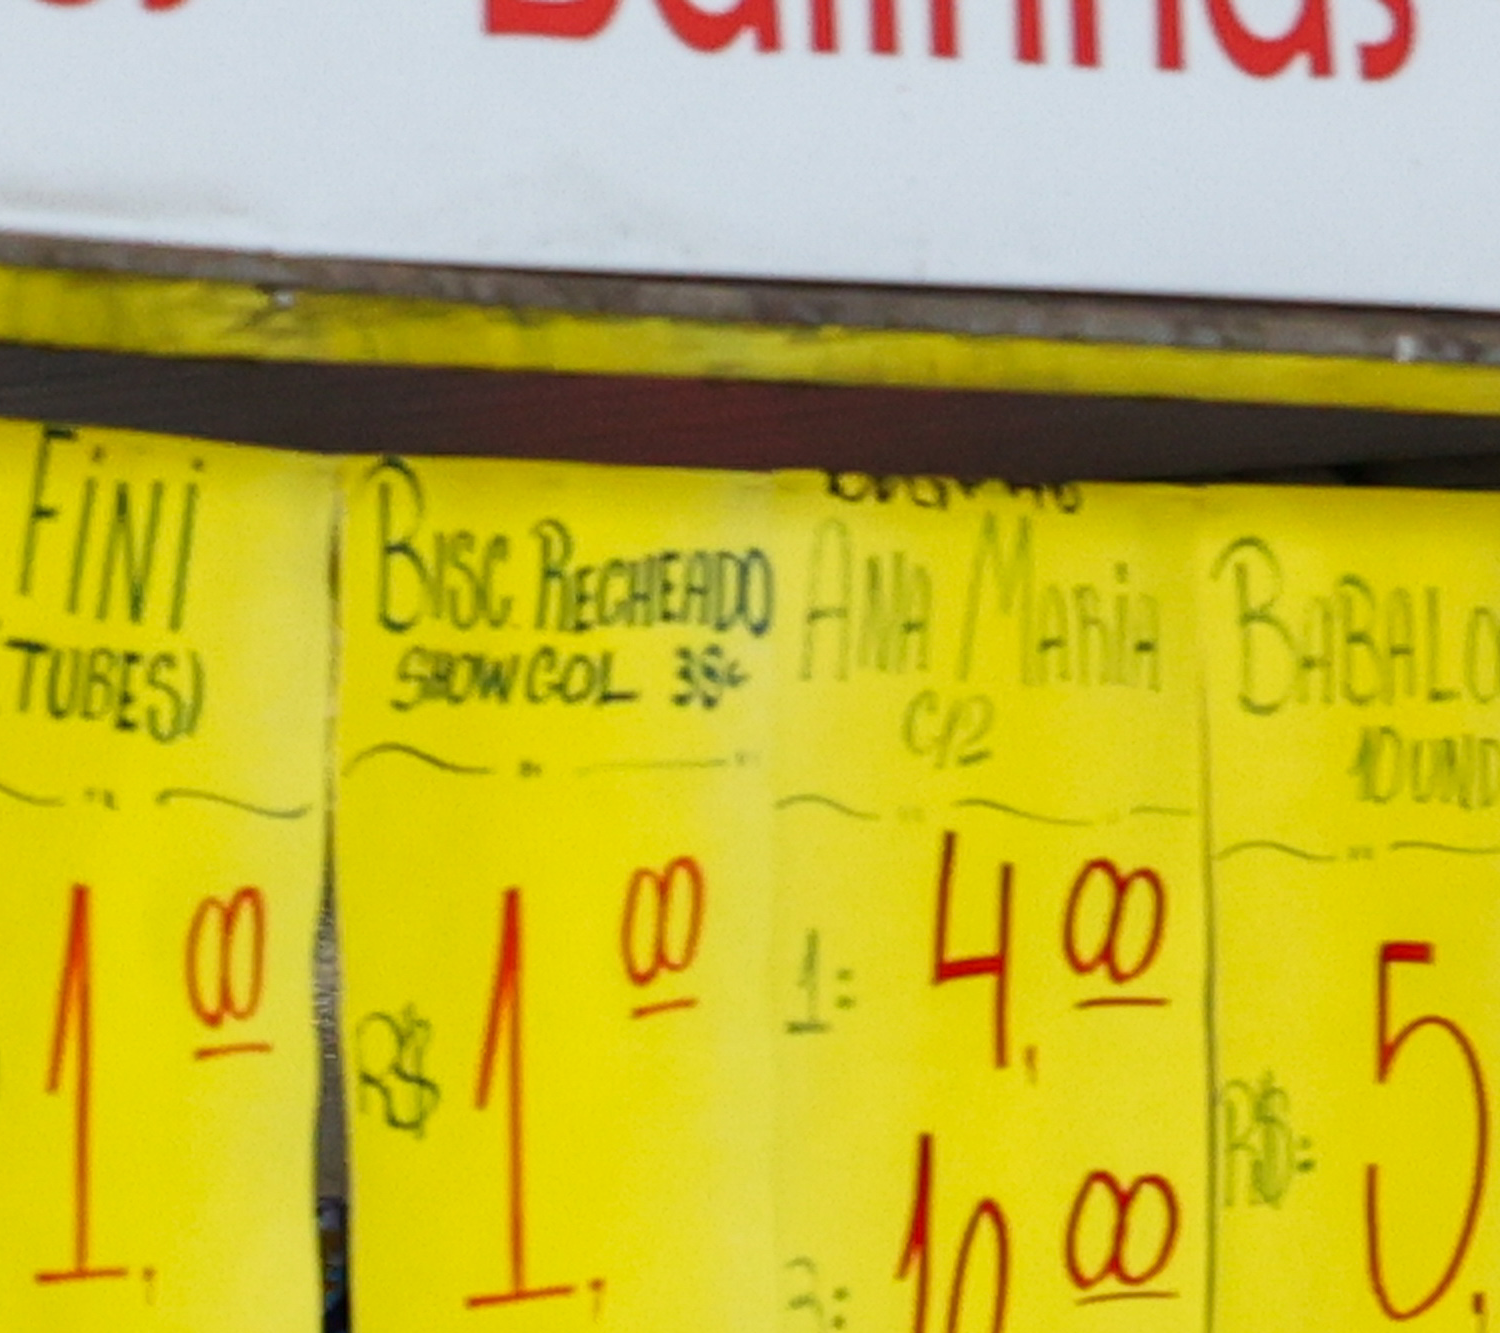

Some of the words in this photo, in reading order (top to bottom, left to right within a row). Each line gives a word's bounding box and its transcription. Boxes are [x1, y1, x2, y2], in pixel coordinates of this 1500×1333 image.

[528, 516, 778, 641] RECHEADO
[798, 518, 937, 682] ANA
[950, 510, 1164, 697] MARIA
